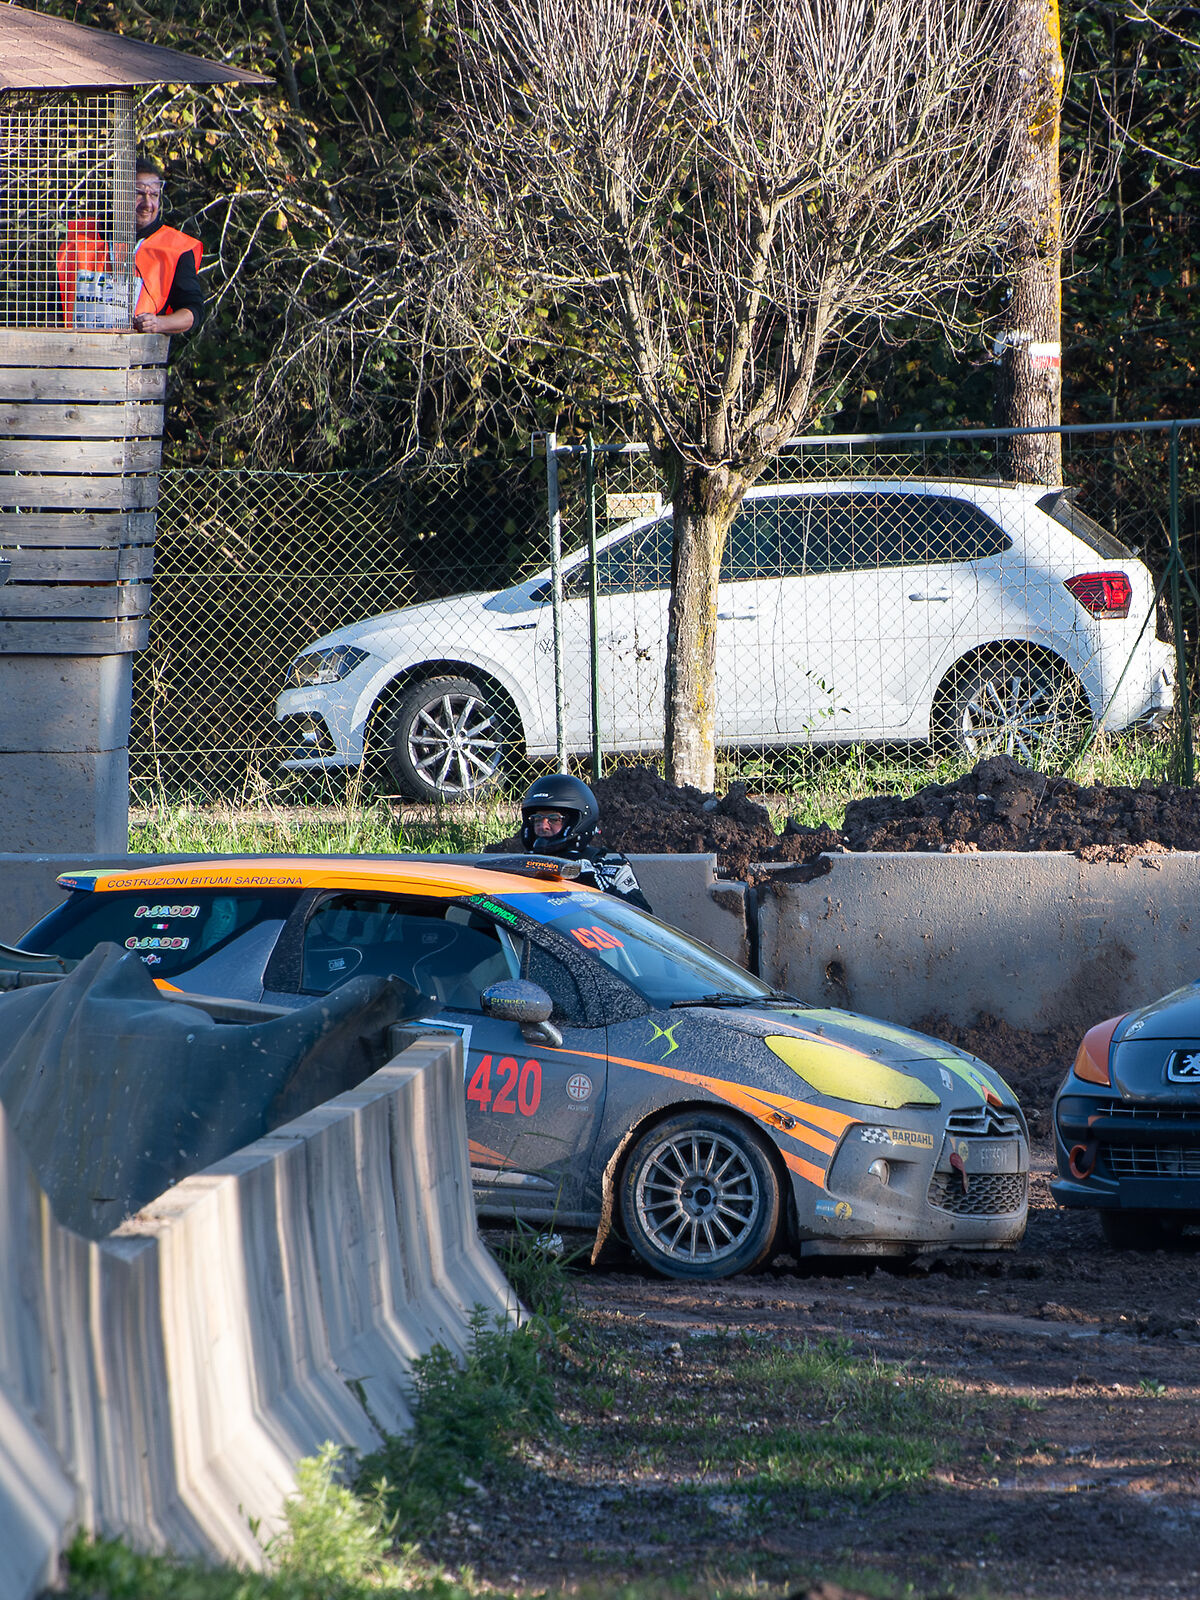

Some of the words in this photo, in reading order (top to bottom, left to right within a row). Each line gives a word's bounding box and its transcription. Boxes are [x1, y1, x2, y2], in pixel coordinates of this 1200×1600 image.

[107, 878, 189, 889] COSTRUZIONI
[191, 877, 232, 885] BITUMI
[235, 876, 303, 886] SARDEGNA
[134, 905, 200, 918] P.SADDI
[570, 926, 625, 951] 420
[467, 1055, 542, 1117] 420
[891, 1130, 933, 1145] BARDAHL
